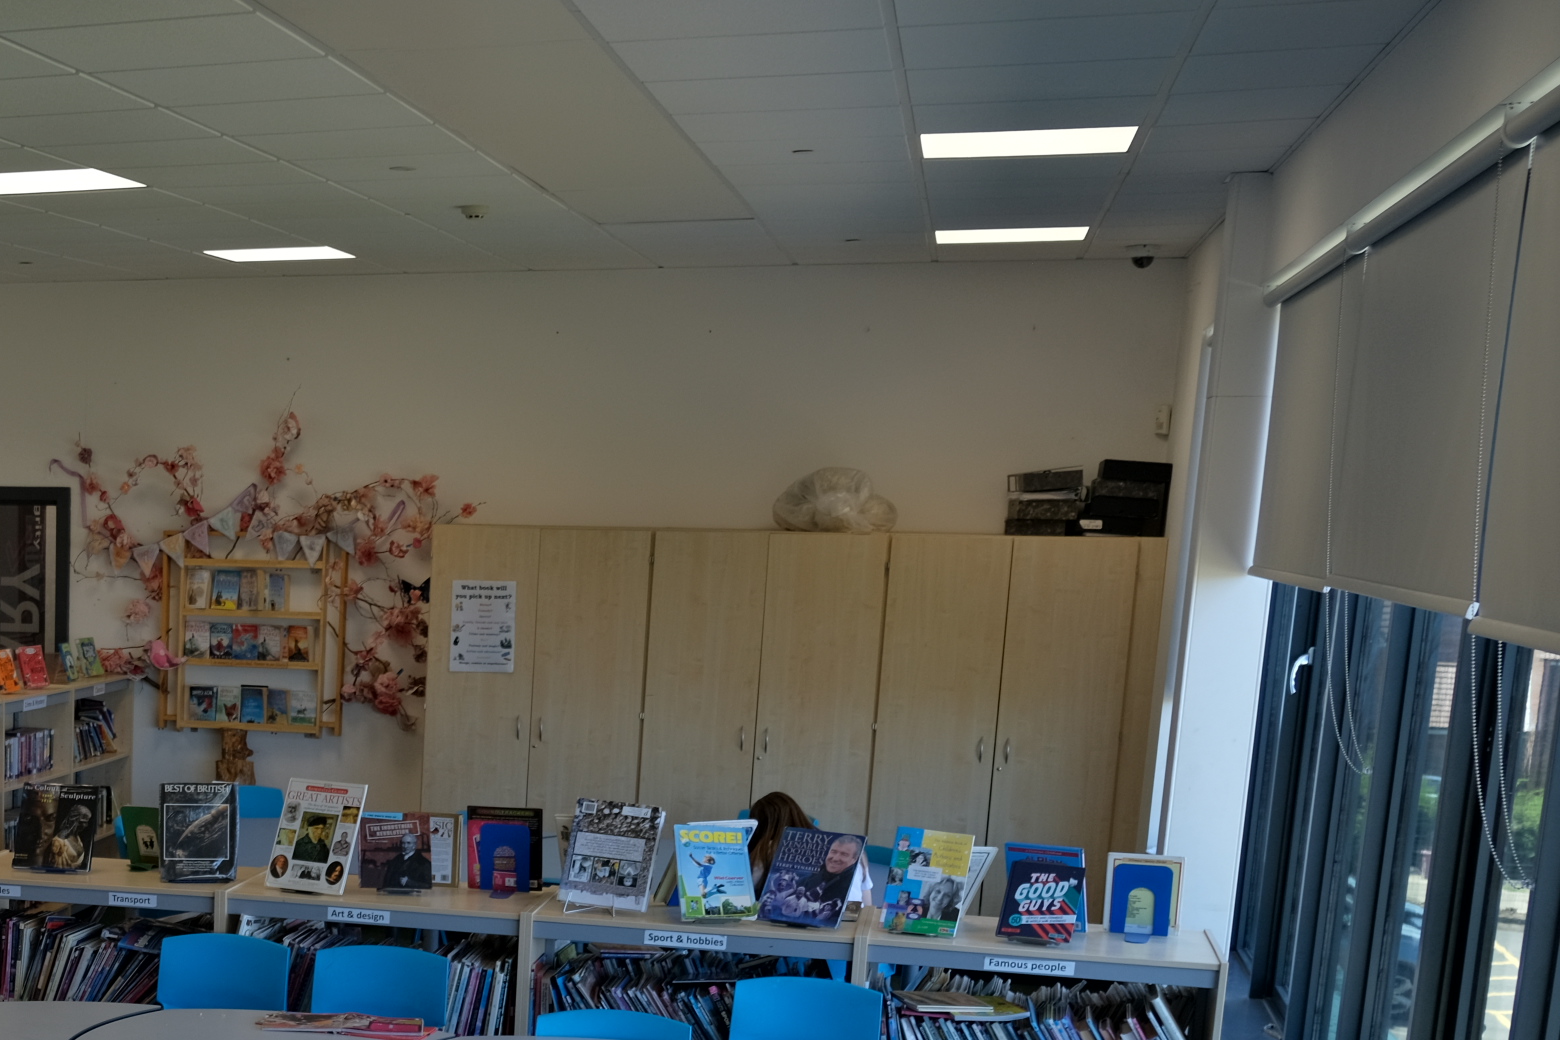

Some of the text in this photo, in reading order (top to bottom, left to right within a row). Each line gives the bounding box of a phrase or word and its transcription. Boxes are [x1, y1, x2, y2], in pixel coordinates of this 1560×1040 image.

[164, 785, 231, 793] BEST OF BRITISH
[60, 792, 96, 801] Sculpture
[288, 790, 320, 803] GREAT
[323, 794, 362, 806] ARTISTS
[679, 830, 743, 844] SCORE!
[786, 831, 834, 845] TERRY
[780, 846, 827, 858] FOOTBALL
[778, 853, 826, 866] HEROES
[1029, 872, 1056, 883] THE
[1014, 883, 1071, 899] GOOD
[112, 895, 151, 905] Transport
[1018, 899, 1063, 912] GUYS
[331, 909, 385, 922] Art & design
[648, 933, 724, 947] Sport & hobbies
[989, 958, 1067, 973] Famous people
